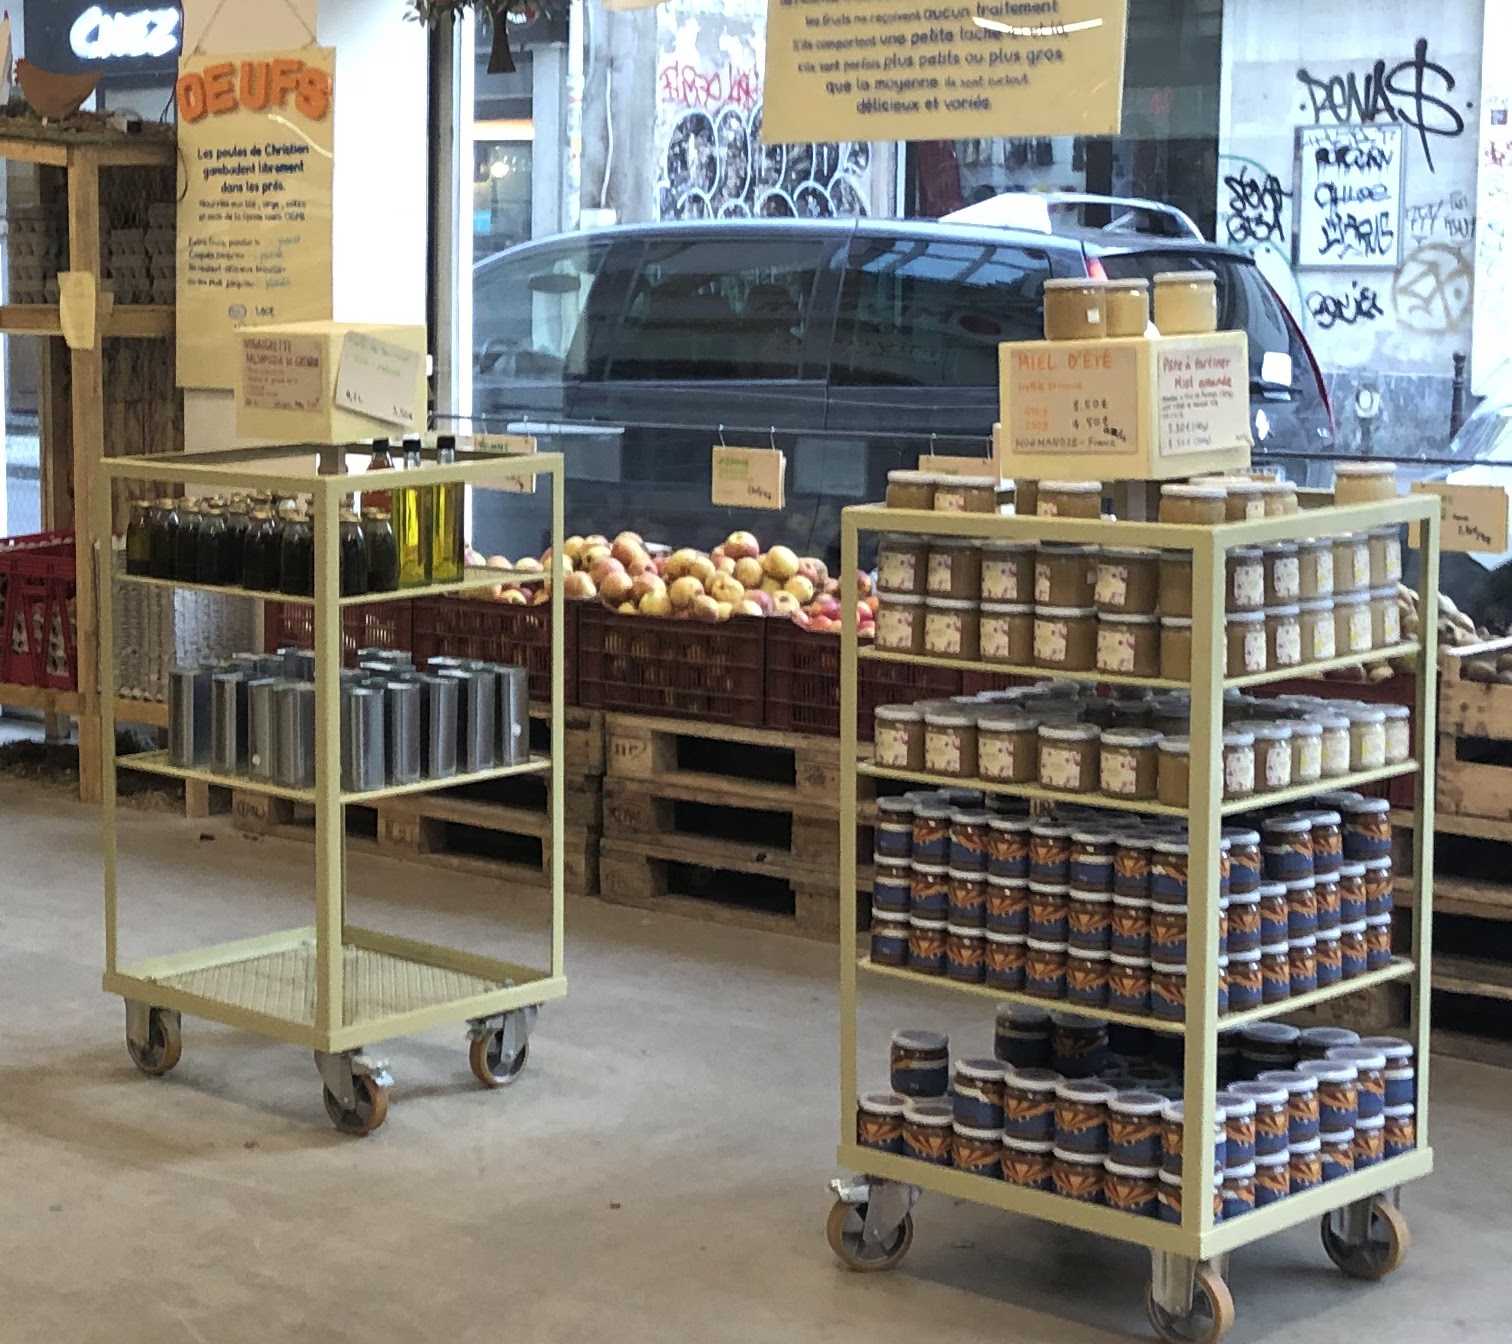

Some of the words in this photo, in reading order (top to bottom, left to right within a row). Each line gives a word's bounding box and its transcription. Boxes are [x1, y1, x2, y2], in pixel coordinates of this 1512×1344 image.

[924, 7, 970, 21] aucun
[880, 33, 906, 46] une
[911, 27, 954, 47] petite
[884, 52, 913, 71] plus
[919, 50, 960, 70] petits
[964, 52, 984, 64] ou
[989, 47, 1021, 68] plus
[1026, 48, 1064, 68] gros
[176, 59, 333, 123] OEUFS
[825, 80, 852, 95] que
[856, 77, 870, 91] la
[875, 78, 938, 95] moyenne
[856, 97, 919, 115] délicieux
[924, 96, 939, 111] et
[198, 148, 213, 160] Les
[216, 145, 247, 161] poules
[250, 145, 261, 156] de
[265, 143, 309, 157] Christian
[203, 162, 255, 180] gambadent
[258, 160, 304, 174] librement
[221, 181, 243, 194] dans
[246, 180, 259, 193] les
[1018, 353, 1056, 370] MIEL
